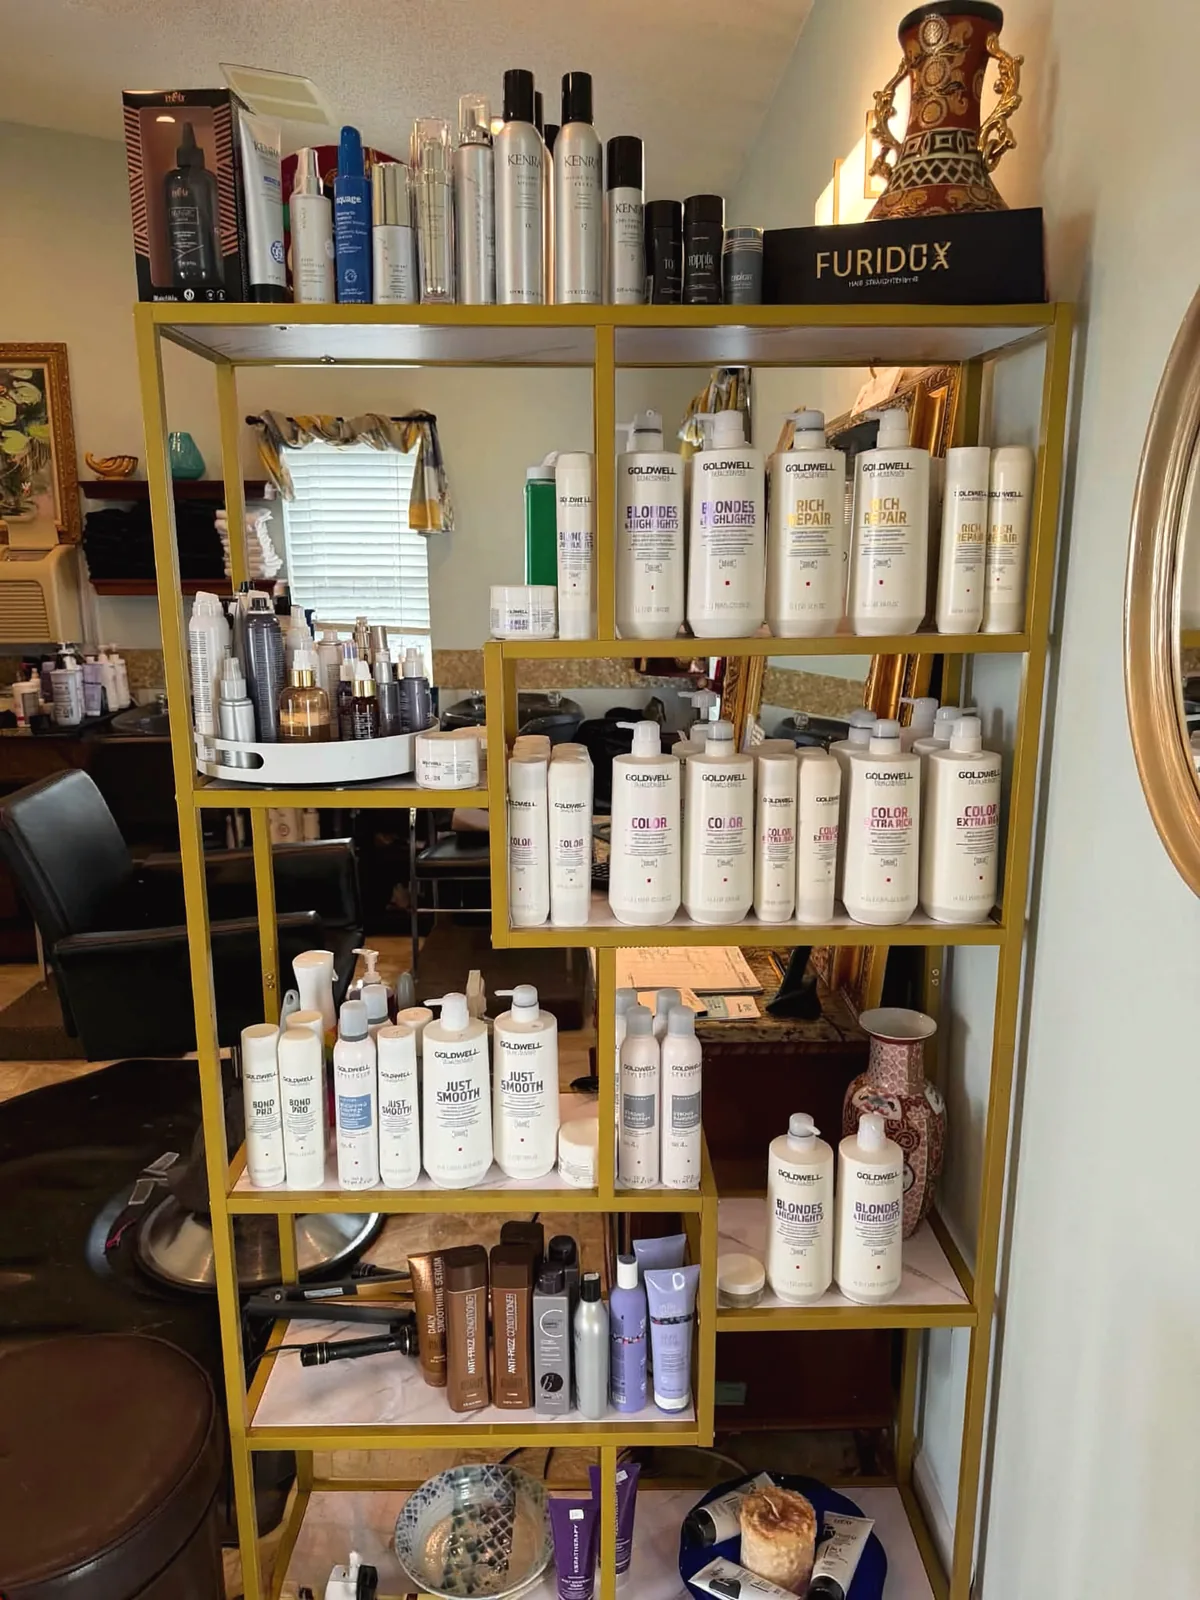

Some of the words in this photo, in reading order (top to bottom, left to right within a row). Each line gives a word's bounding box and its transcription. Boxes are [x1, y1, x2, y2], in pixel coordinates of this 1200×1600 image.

[616, 203, 642, 214] KEN
[628, 466, 677, 475] GOLDWELL
[702, 461, 754, 470] GOLDWELL
[785, 463, 836, 473] GOLDWELL
[862, 462, 916, 472] GOLDWELL
[702, 500, 755, 515] BONDES
[796, 499, 825, 513] RICH
[629, 519, 678, 529] HIGHIGHTS
[625, 773, 672, 782] GOLDWELL
[701, 773, 747, 782] GOLDWELL
[865, 772, 914, 780] GOLDWELL
[871, 806, 908, 819] COLOR
[631, 817, 667, 829] COLOR
[707, 816, 743, 829] COLOR
[865, 818, 894, 828] XTRA
[500, 1040, 542, 1050] GOLDWELL
[434, 1048, 480, 1060] GOLDWELL
[509, 1071, 535, 1082] JUST
[446, 1079, 472, 1092] JUST
[501, 1079, 544, 1093] SMOOTH
[436, 1087, 480, 1102] SMOOTH
[252, 1098, 275, 1109] BOND
[289, 1098, 311, 1107] BOND
[387, 1099, 407, 1108] JUST
[256, 1107, 273, 1116] PRO
[291, 1105, 309, 1114] PRO
[778, 1168, 823, 1181] GOLDWELL
[856, 1171, 900, 1181] GOLDWELL
[776, 1198, 823, 1215] BLONDES
[855, 1199, 900, 1216] BLONDES
[433, 1256, 444, 1286] SERUM
[434, 1287, 446, 1334] SMOOTHING
[427, 1314, 436, 1334] DAILY
